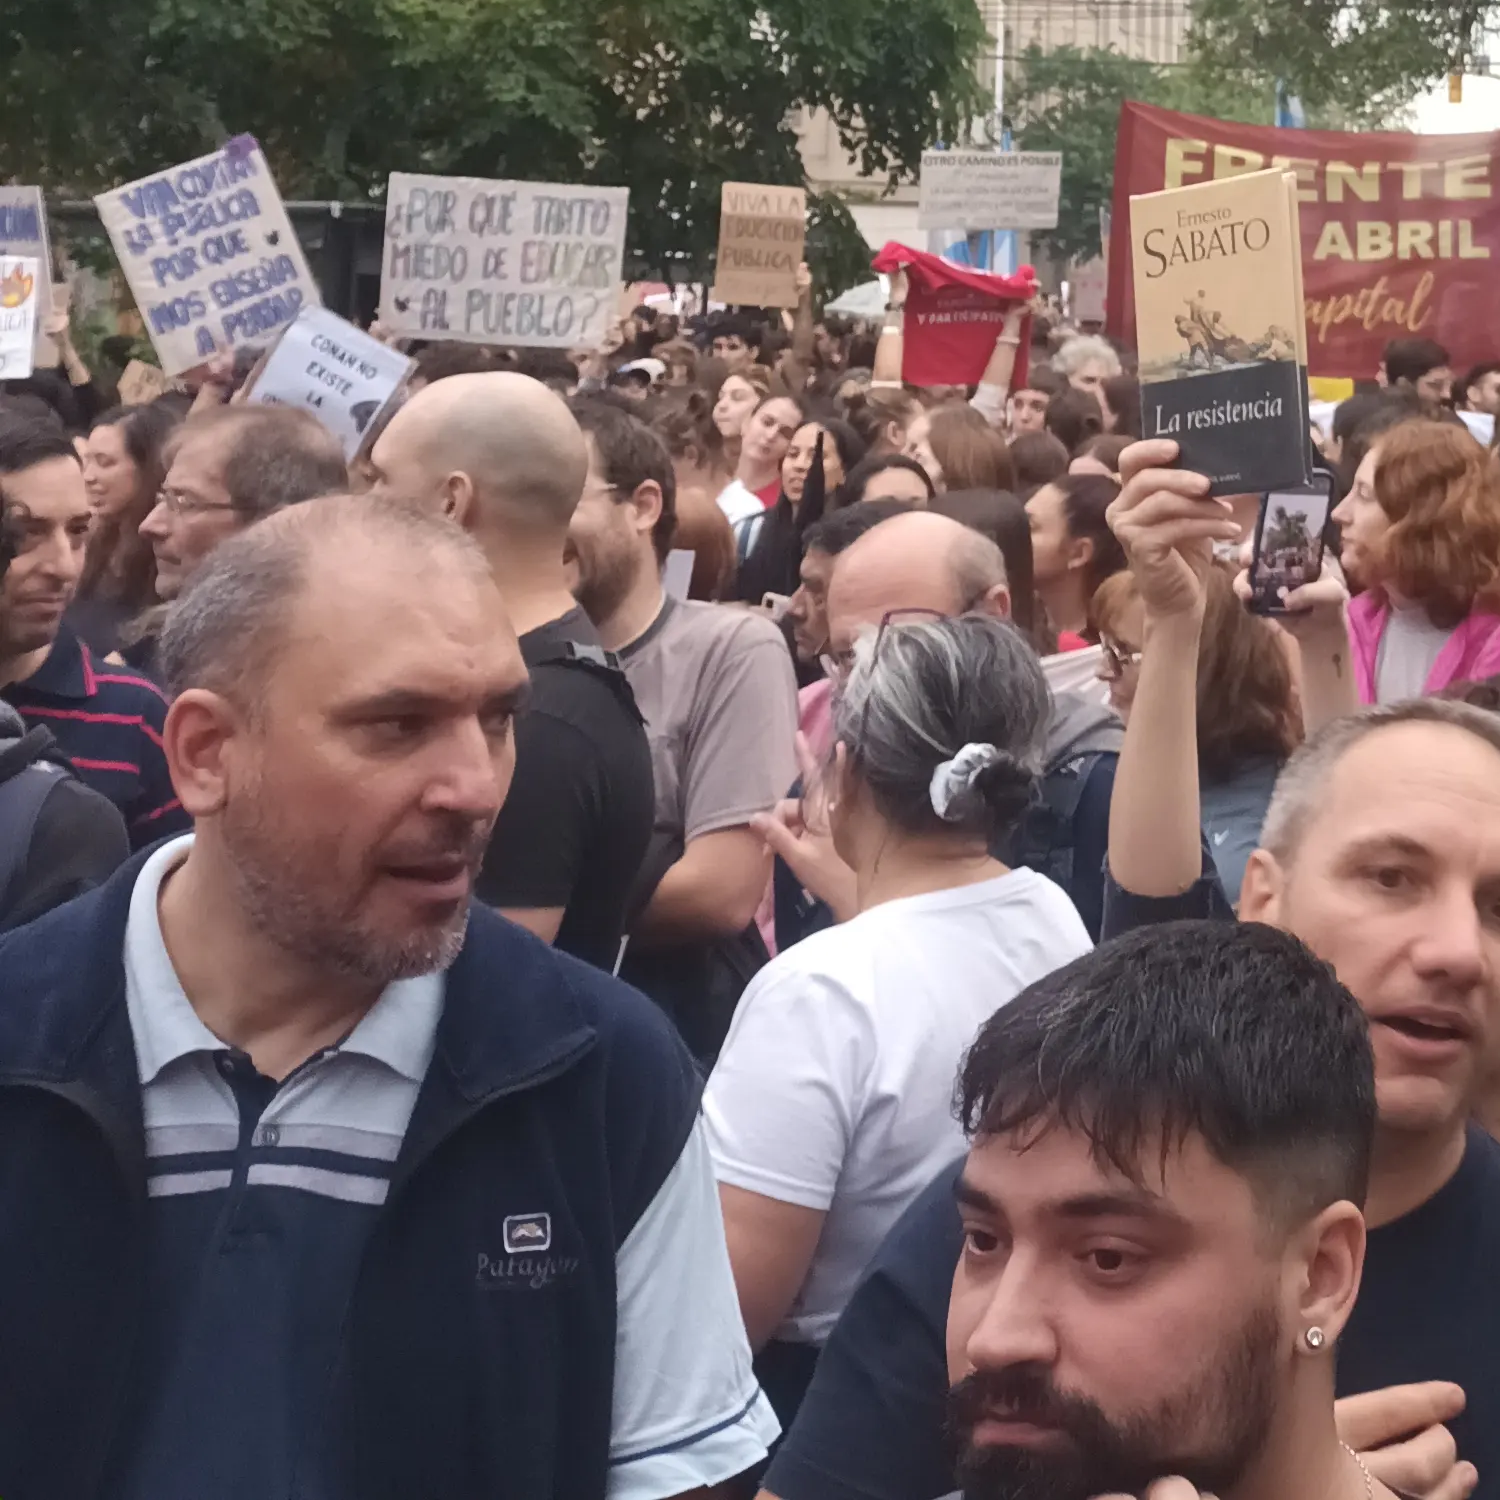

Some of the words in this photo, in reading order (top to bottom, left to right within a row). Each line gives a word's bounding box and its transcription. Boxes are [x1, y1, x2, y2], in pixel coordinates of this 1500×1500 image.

[923, 155, 956, 167] OTRO
[958, 155, 1005, 167] CAMINO
[1164, 138, 1492, 203] FRENTE
[387, 187, 456, 239] ¿POR
[532, 195, 610, 236] TANTO
[727, 191, 770, 214] VIVA
[1176, 206, 1231, 228] Ernesto
[150, 246, 200, 287] POR
[201, 229, 250, 265] QUE
[390, 242, 467, 282] MIEDO
[482, 247, 508, 280] DE
[520, 240, 617, 287] EDUCAR
[1143, 217, 1270, 278] SABATO
[1313, 219, 1491, 262] ABRIL
[149, 290, 206, 335] NOS
[420, 288, 449, 330] AL
[465, 289, 601, 342] PUEBLO?
[1303, 271, 1435, 343] apital
[305, 361, 353, 396] EXISTE
[311, 334, 358, 368] CONAN
[356, 359, 378, 380] NO
[1155, 403, 1180, 436] La
[1186, 391, 1283, 431] resistencia
